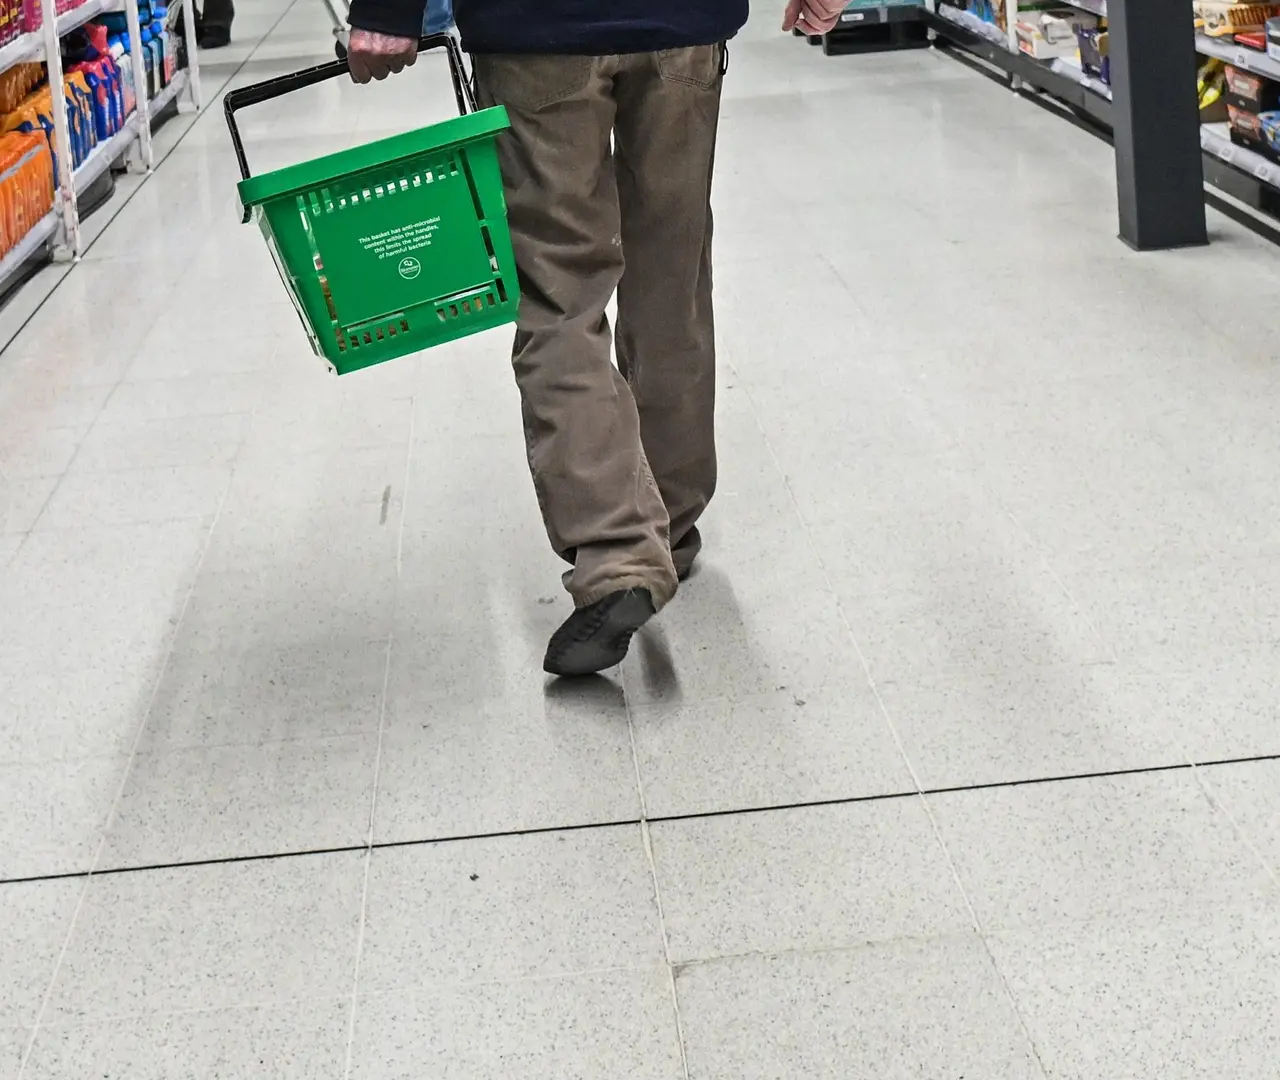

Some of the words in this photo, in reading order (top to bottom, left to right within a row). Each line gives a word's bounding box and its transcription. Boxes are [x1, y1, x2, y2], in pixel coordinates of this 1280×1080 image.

[358, 236, 370, 244] This
[371, 230, 390, 240] basket
[391, 227, 401, 235] has
[402, 216, 441, 232] anti-microbial
[364, 239, 386, 250] content
[387, 234, 404, 243] within
[374, 246, 385, 254] this
[386, 242, 401, 250] limits
[413, 232, 432, 243] spread
[386, 246, 408, 258] harmful
[408, 240, 432, 251] bacteria
